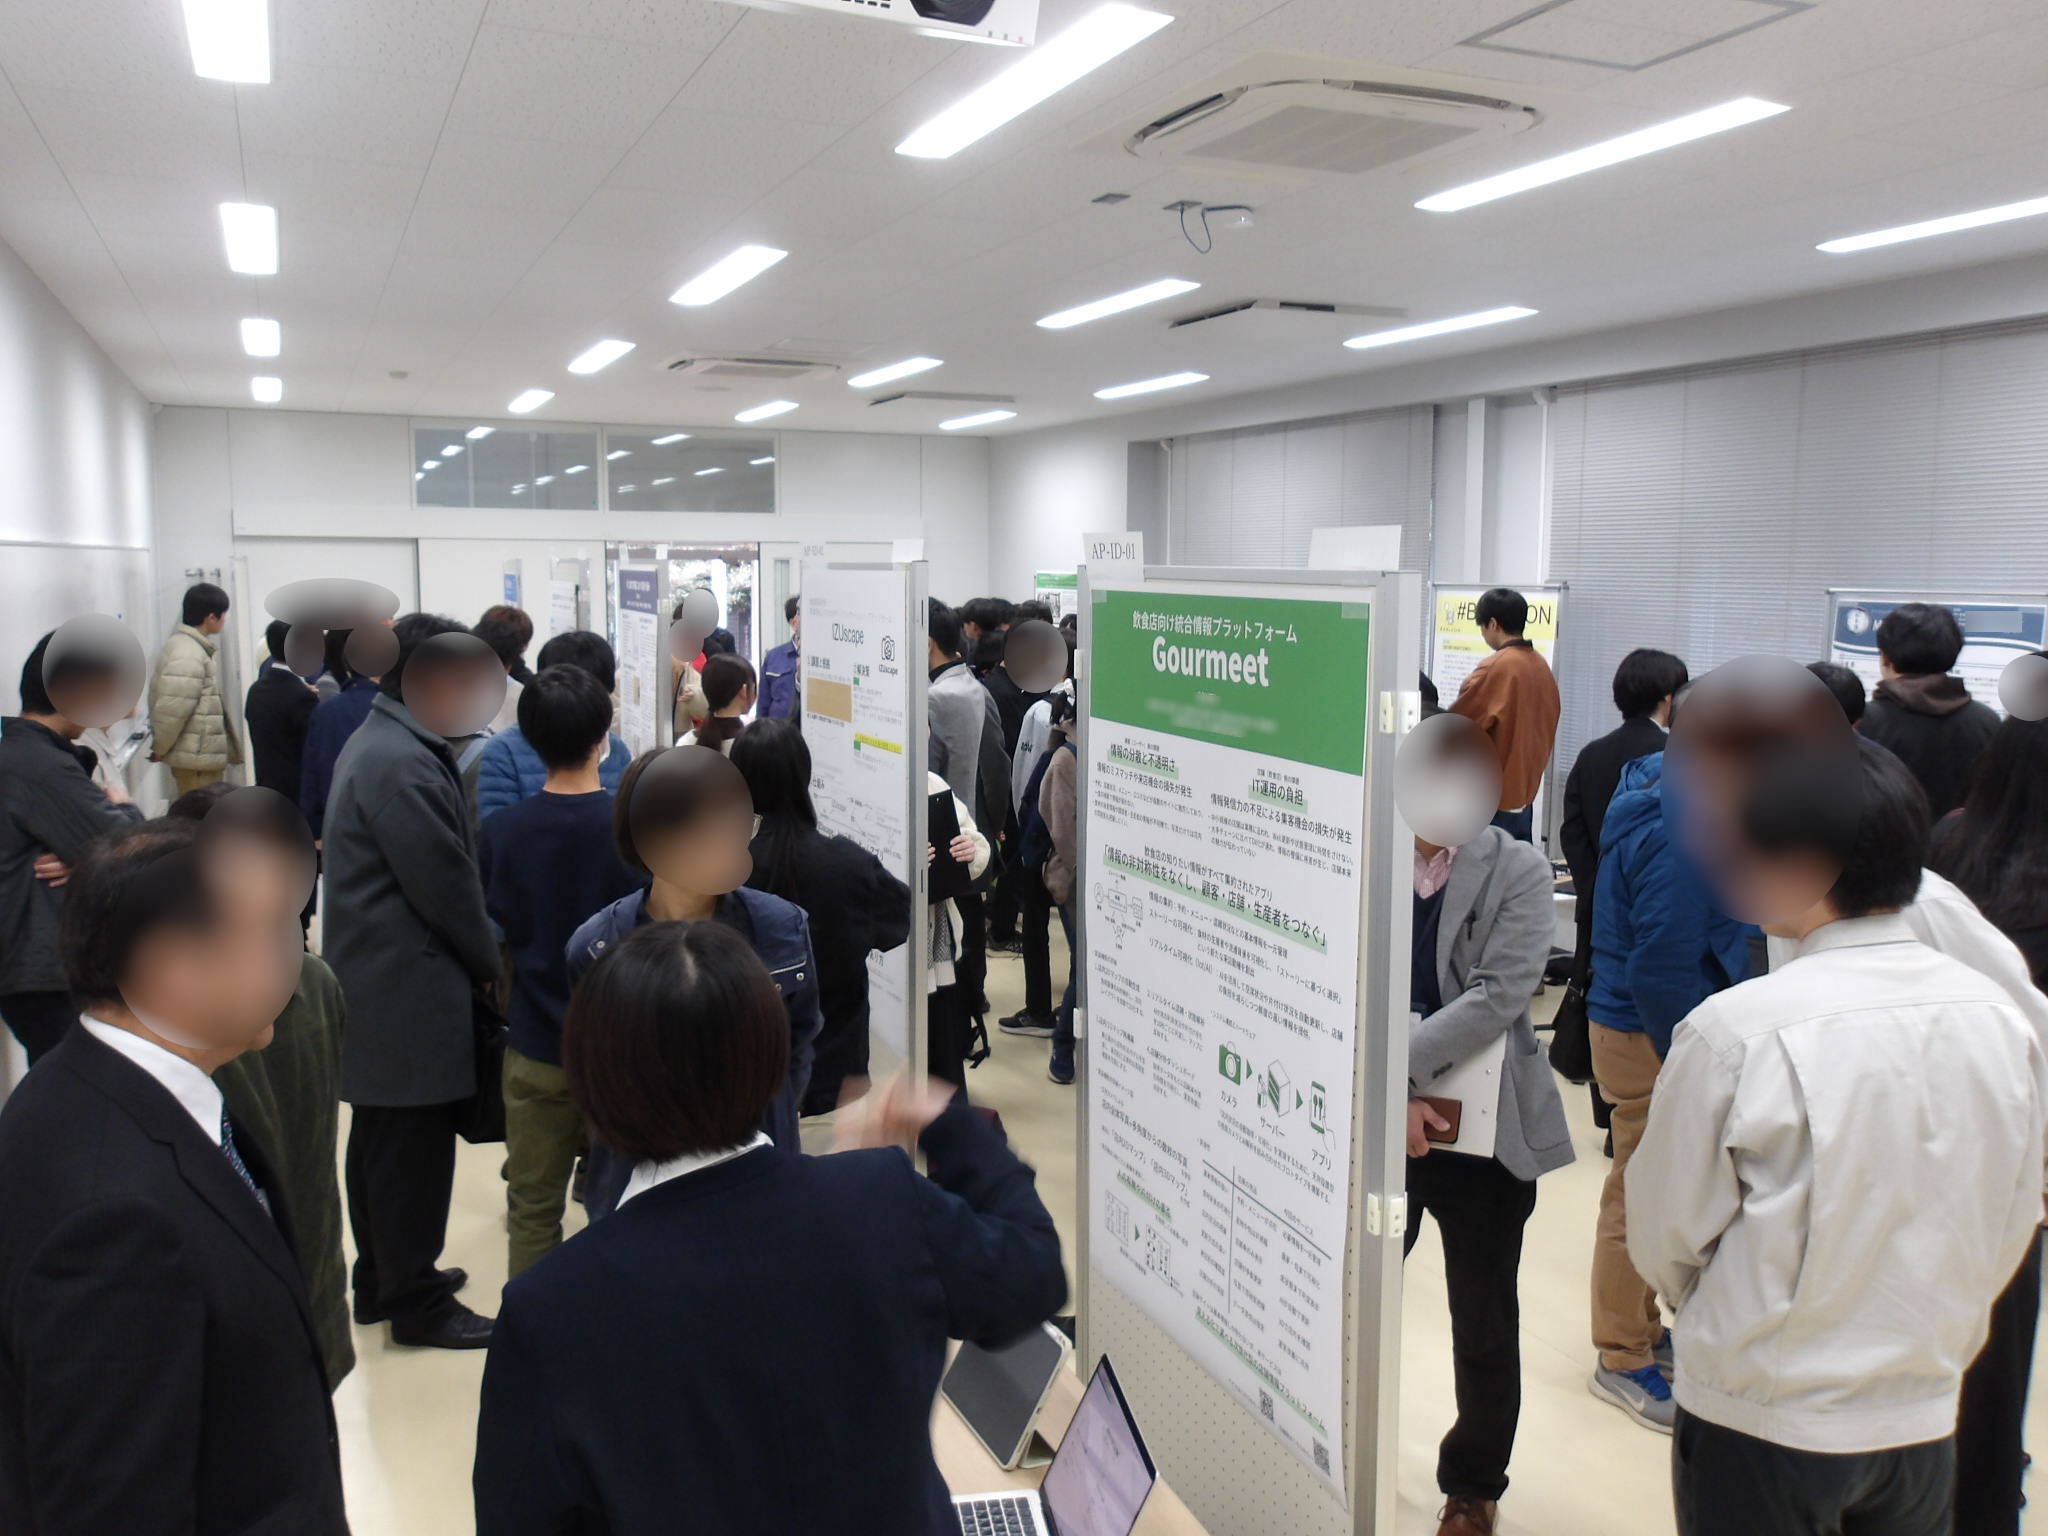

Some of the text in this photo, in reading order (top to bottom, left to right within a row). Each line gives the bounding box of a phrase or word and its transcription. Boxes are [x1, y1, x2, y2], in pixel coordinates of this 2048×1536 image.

[1092, 542, 1136, 560] AP-ID-01
[832, 623, 864, 645] IZUscape
[1132, 610, 1298, 643] 飲食店向け統合情報プラットフォーム
[1152, 635, 1269, 687] Gourmeet
[1110, 743, 1175, 773] 情報の分散と不透明さ
[1096, 761, 1193, 798] 情報のミスマッチや来店機会の損失が発生
[1252, 778, 1303, 806] IT運用の負担
[1210, 793, 1352, 845] 情報発信力の不足による集客機会の損失が発生
[1144, 845, 1273, 901] 飲食店の知りたい情報がすべて集約されたアプリ
[1104, 844, 1326, 947] 「情報の非対称性をなくし、顧客・店舗・生産者をつなぐ」
[1221, 1090, 1237, 1108] カメラ
[1260, 1116, 1285, 1137] サーバー
[1311, 1148, 1331, 1171] アプリ
